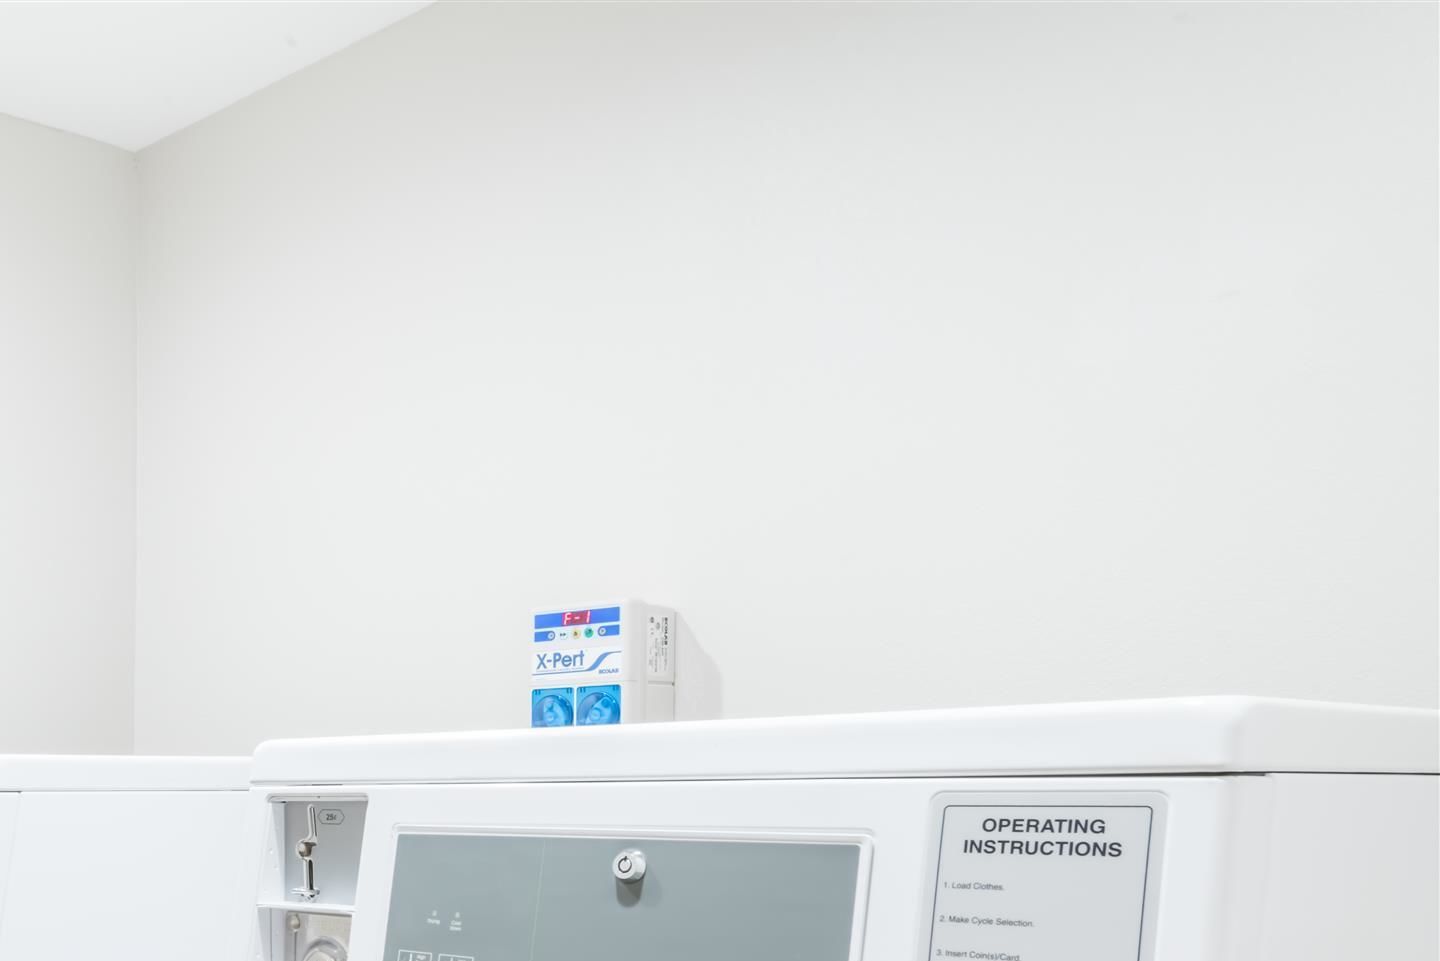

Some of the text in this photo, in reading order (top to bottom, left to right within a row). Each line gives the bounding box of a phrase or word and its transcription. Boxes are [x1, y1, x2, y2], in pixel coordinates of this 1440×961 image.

[536, 650, 585, 669] X-Pert
[982, 818, 1106, 834] OPERATING
[963, 839, 1123, 857] INSTRUCTIONS
[952, 882, 971, 890] Load
[973, 882, 1004, 891] Clothes.
[949, 915, 969, 924] Make
[971, 916, 993, 927] Cycle
[996, 918, 1034, 928] Selection.
[945, 949, 967, 958] Insert
[969, 950, 1021, 961] Coin(s)/Card.
